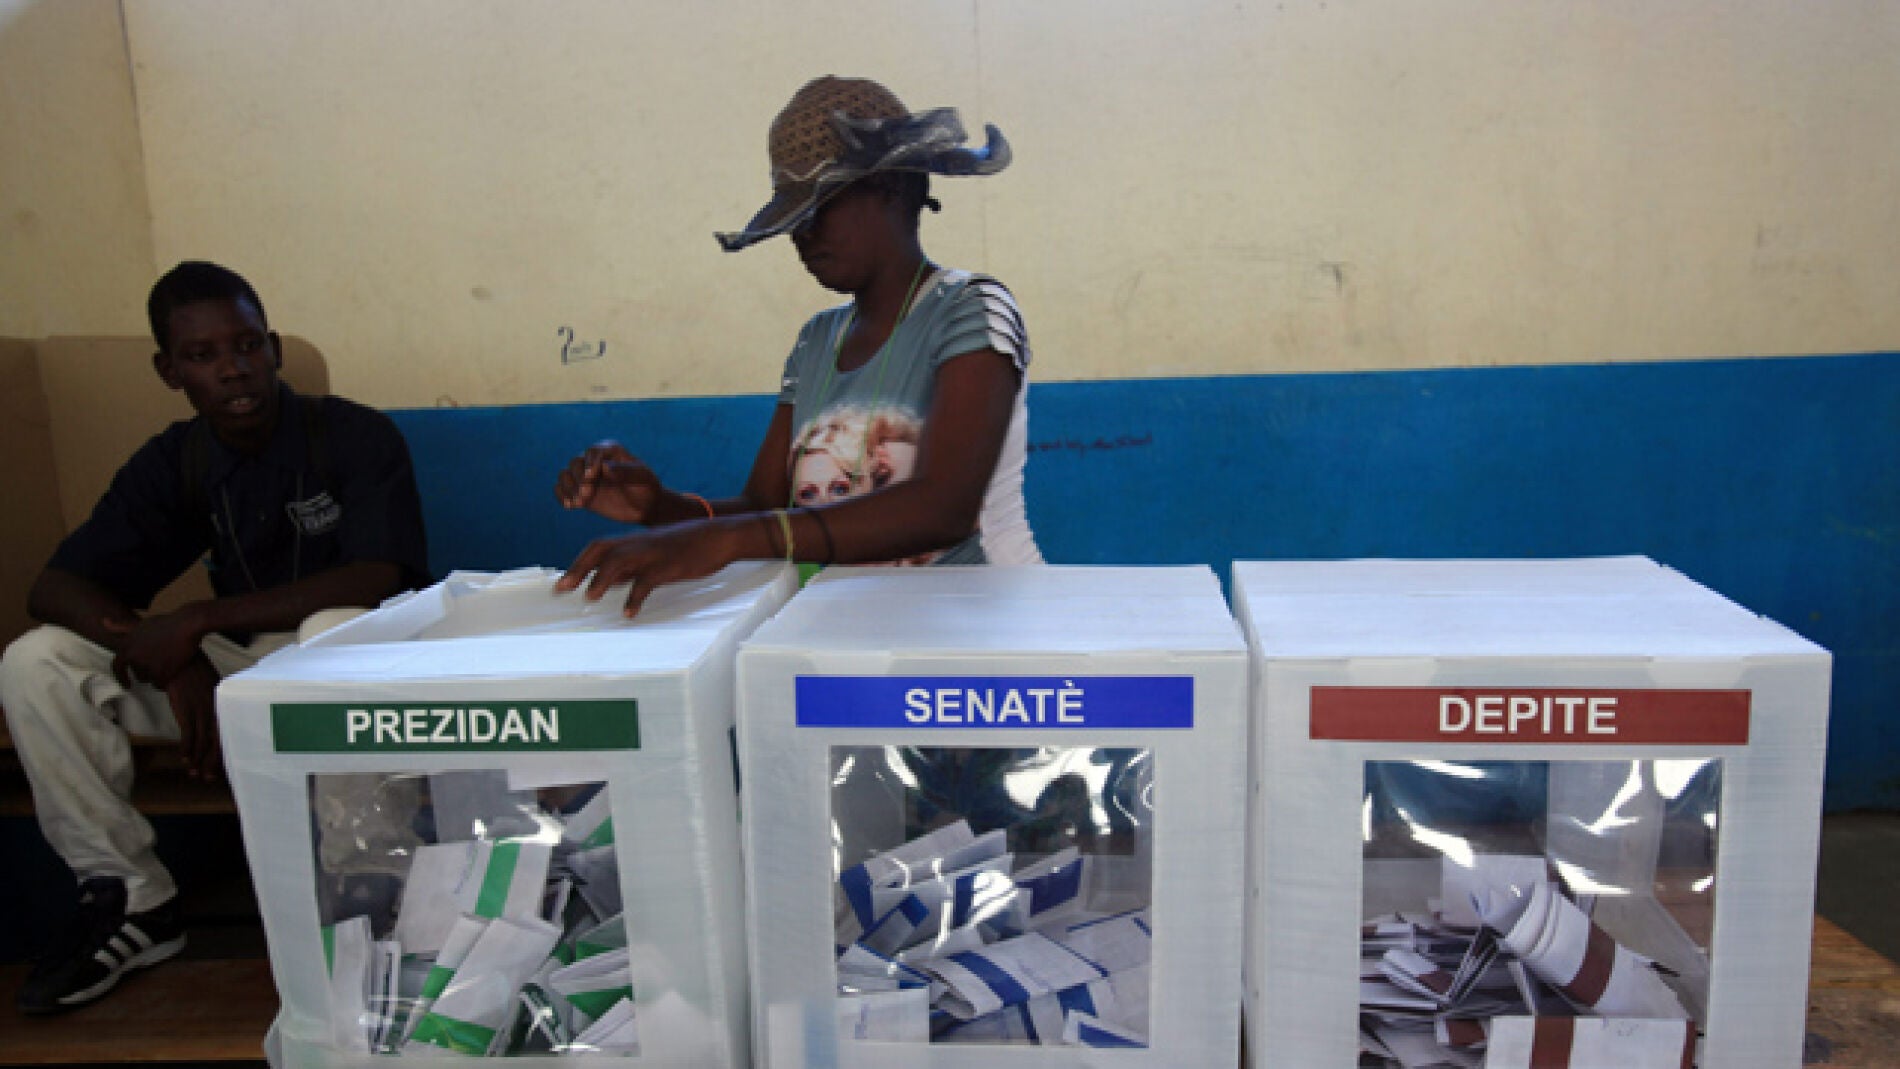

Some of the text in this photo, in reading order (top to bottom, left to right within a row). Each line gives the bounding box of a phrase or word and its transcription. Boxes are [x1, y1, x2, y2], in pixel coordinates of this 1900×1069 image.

[904, 679, 1084, 724] SENATÈ
[1438, 696, 1618, 735] DEPITE
[346, 708, 559, 743] PREZIDAN
